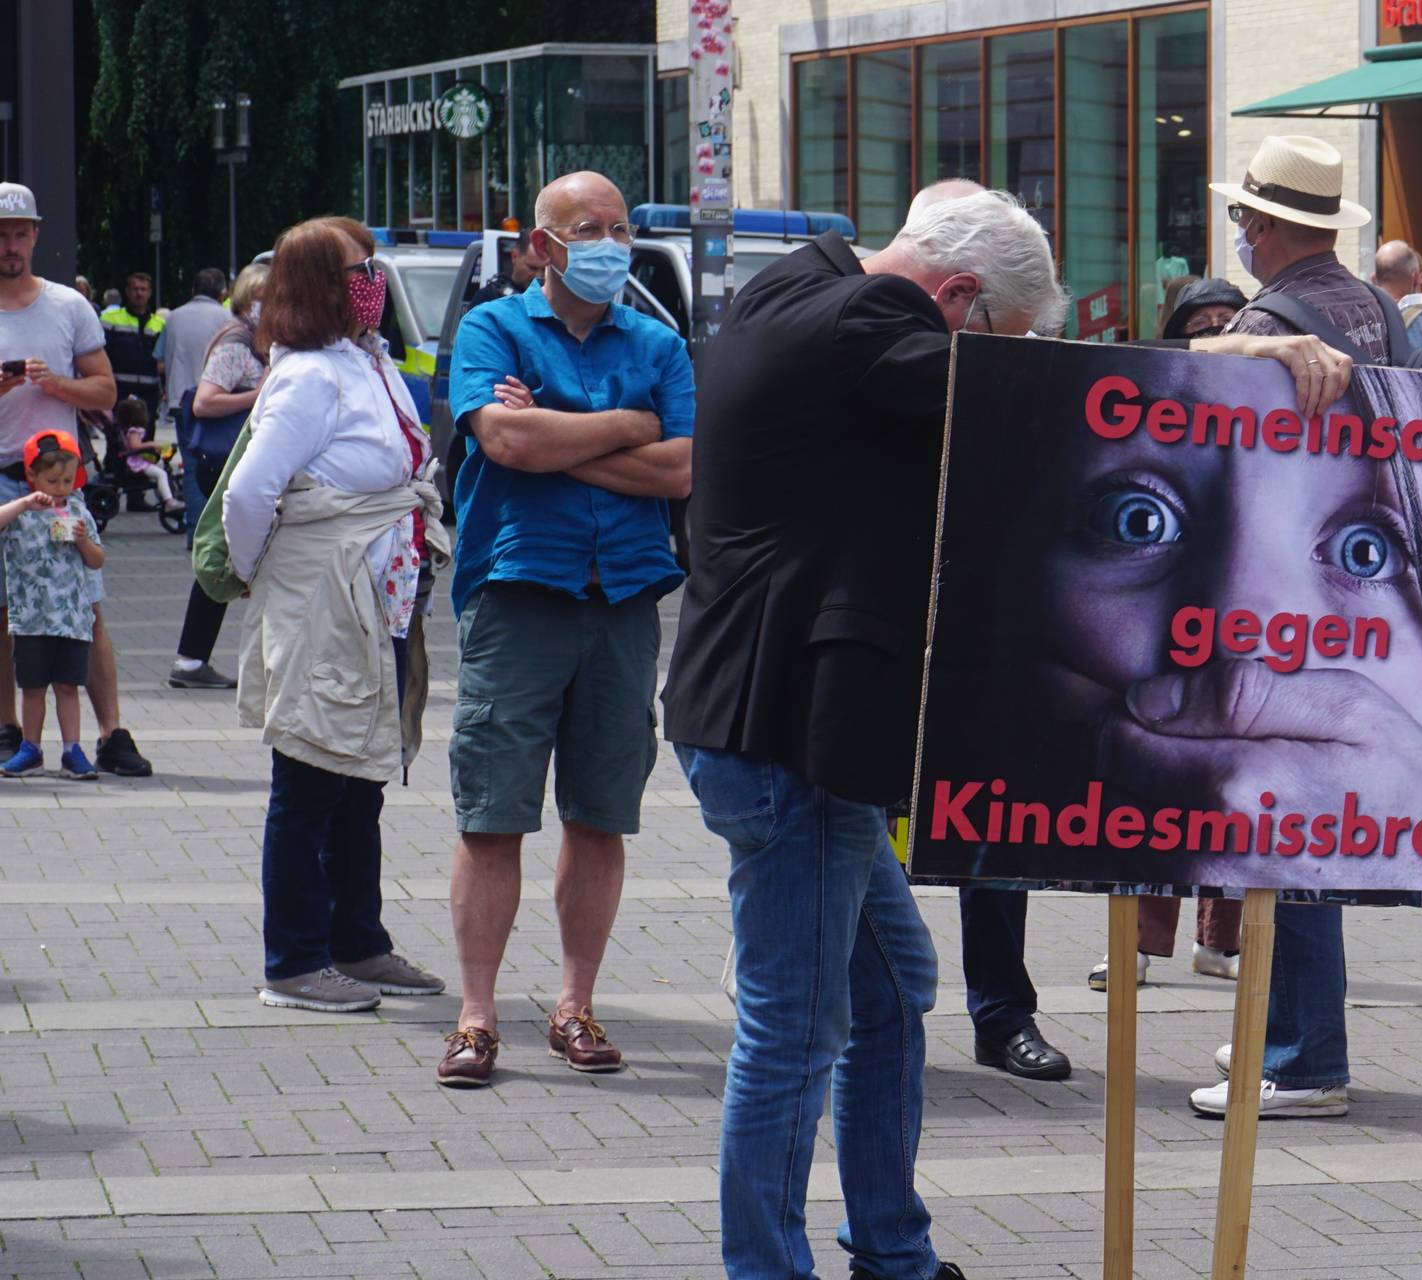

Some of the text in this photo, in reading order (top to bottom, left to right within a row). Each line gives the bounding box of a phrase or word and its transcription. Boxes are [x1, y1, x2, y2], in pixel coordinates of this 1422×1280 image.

[367, 100, 432, 138] STARBUCKS
[1090, 294, 1108, 321] SALE
[1170, 606, 1389, 673] gegen
